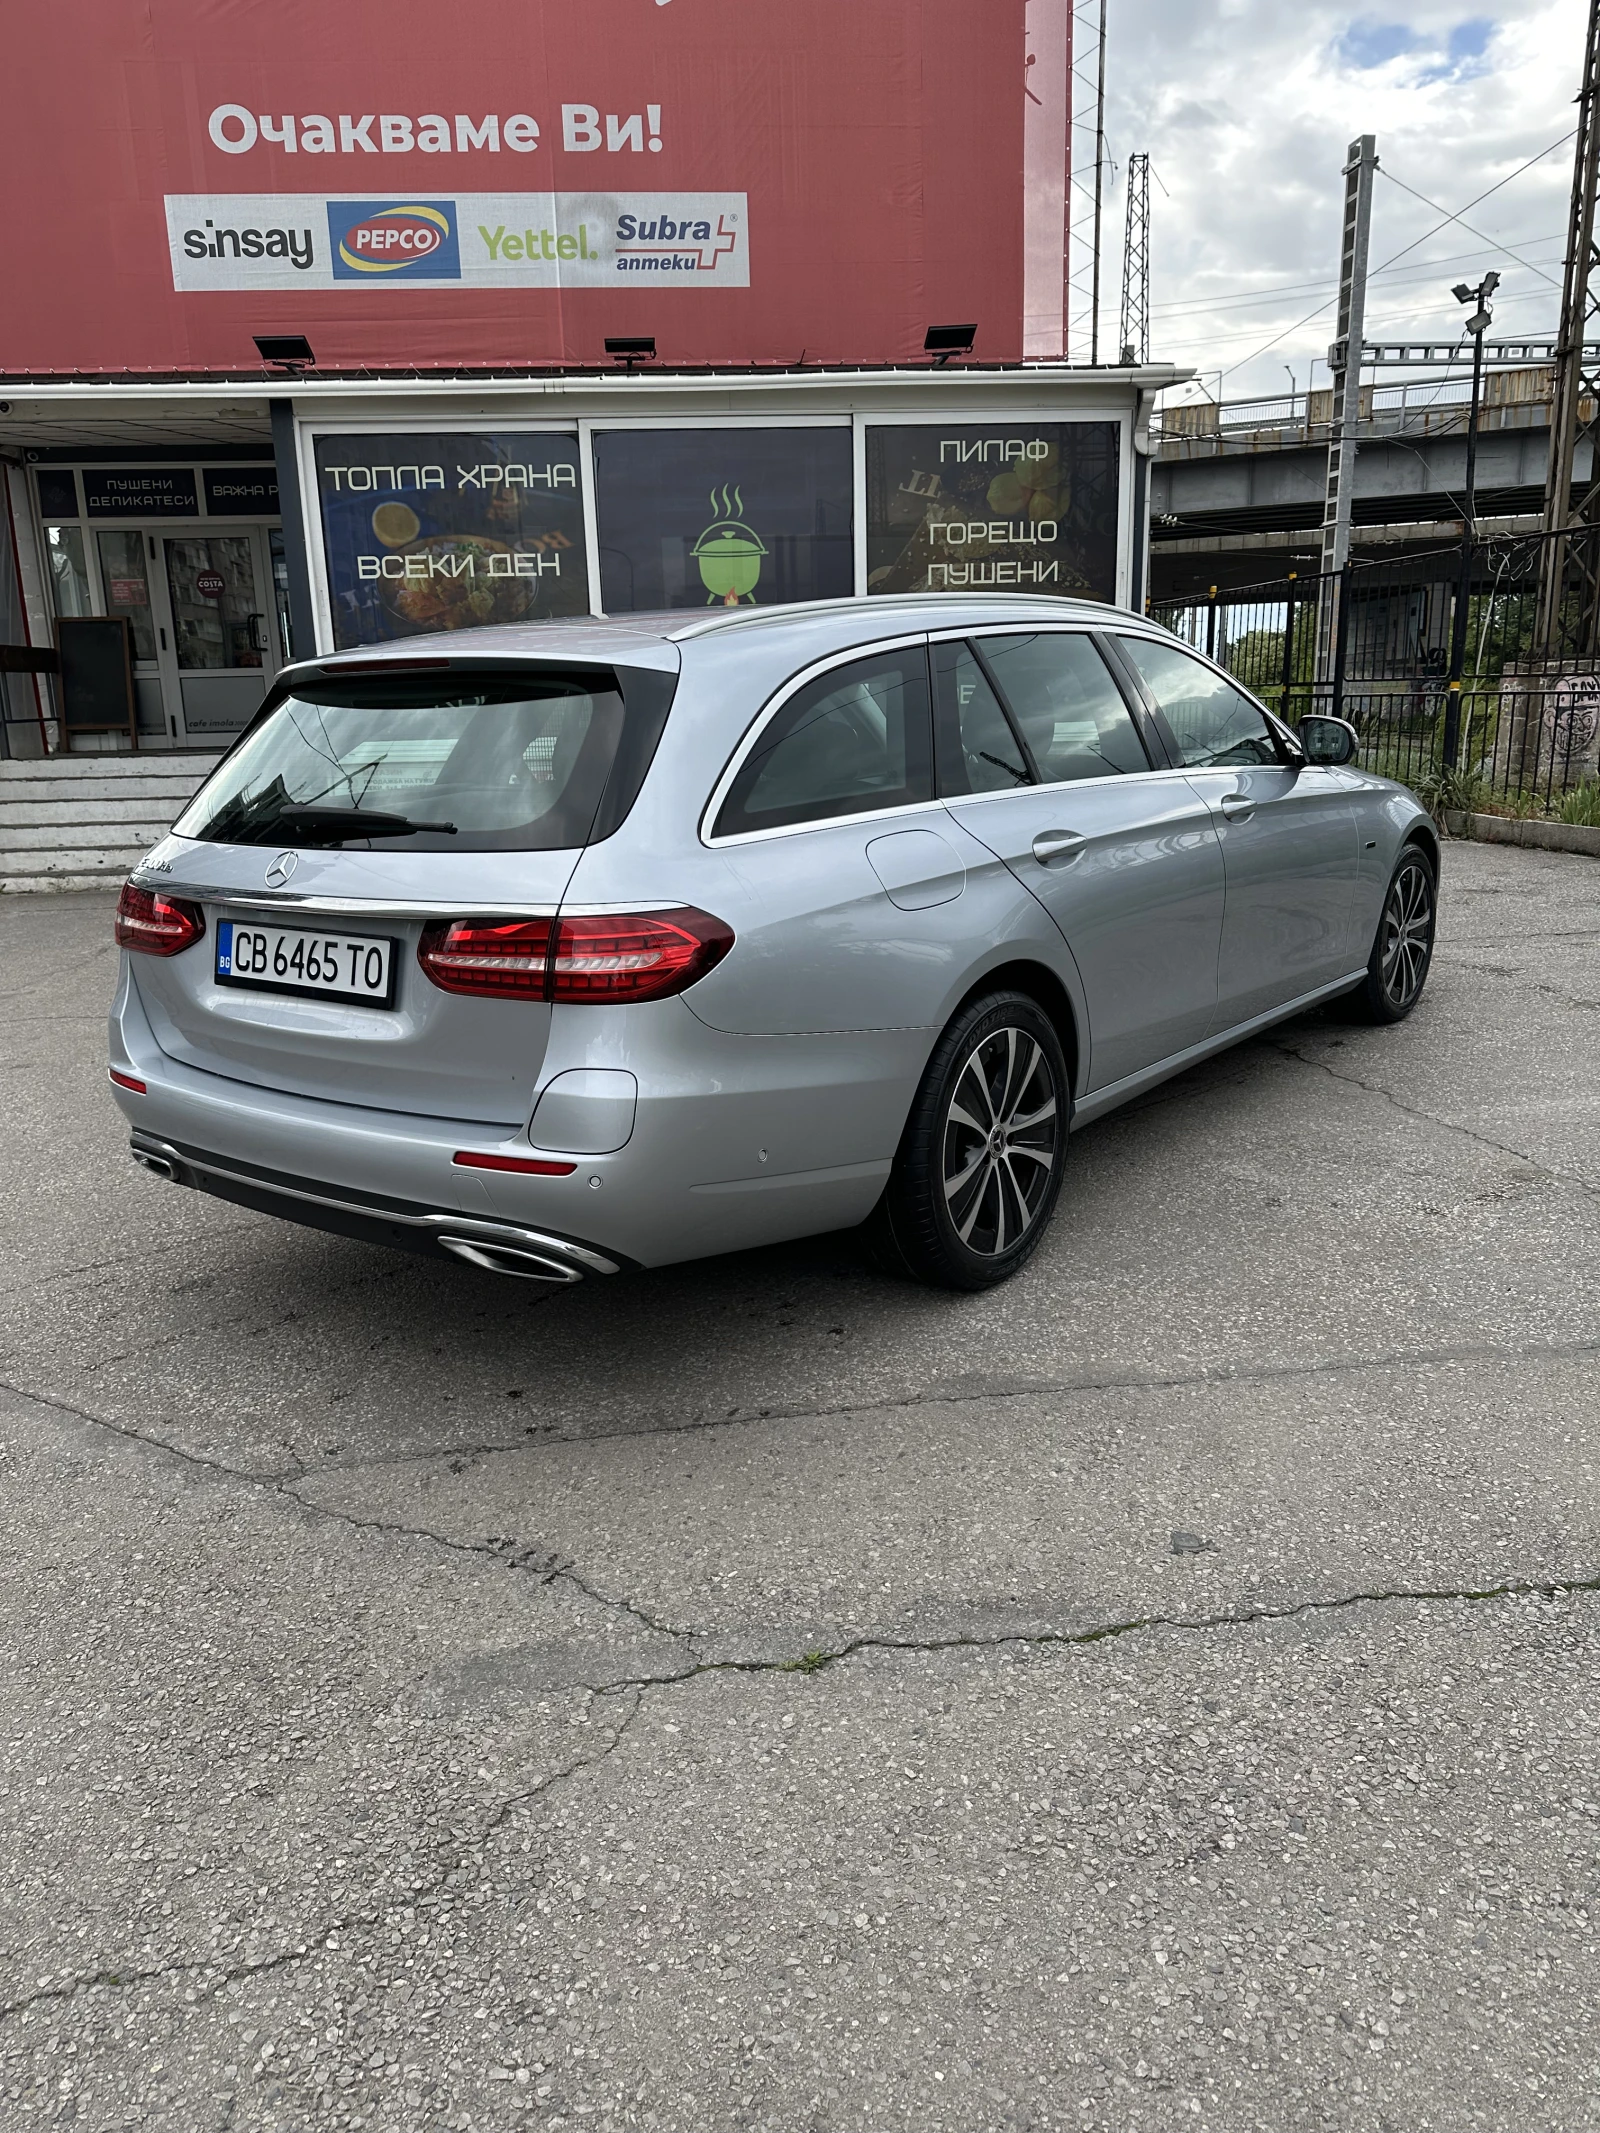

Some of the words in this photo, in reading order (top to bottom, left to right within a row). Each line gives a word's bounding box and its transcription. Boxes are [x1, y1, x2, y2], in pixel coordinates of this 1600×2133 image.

[208, 103, 540, 154] Очакваме
[561, 103, 663, 153] Ви!
[356, 229, 432, 250] PEPCO
[616, 214, 711, 241] Subra
[183, 219, 314, 270] sinsay
[477, 224, 599, 261] Yettel.
[940, 438, 1049, 463] ПИЛАФ
[107, 479, 173, 490] ПУШЕНИ
[324, 465, 445, 491] ТОПЛА
[456, 463, 576, 489] ХРАНА
[89, 495, 195, 507] ДЕЛИКАТЕСИ
[212, 485, 265, 496] ВАЖНА
[929, 520, 1058, 545] ГОРЕЩО
[357, 554, 475, 580] ВСЕКИ
[487, 553, 561, 577] ДЕН
[928, 560, 1058, 586] ПУШЕНИ
[198, 580, 224, 588] COSTA
[219, 957, 231, 969] BG
